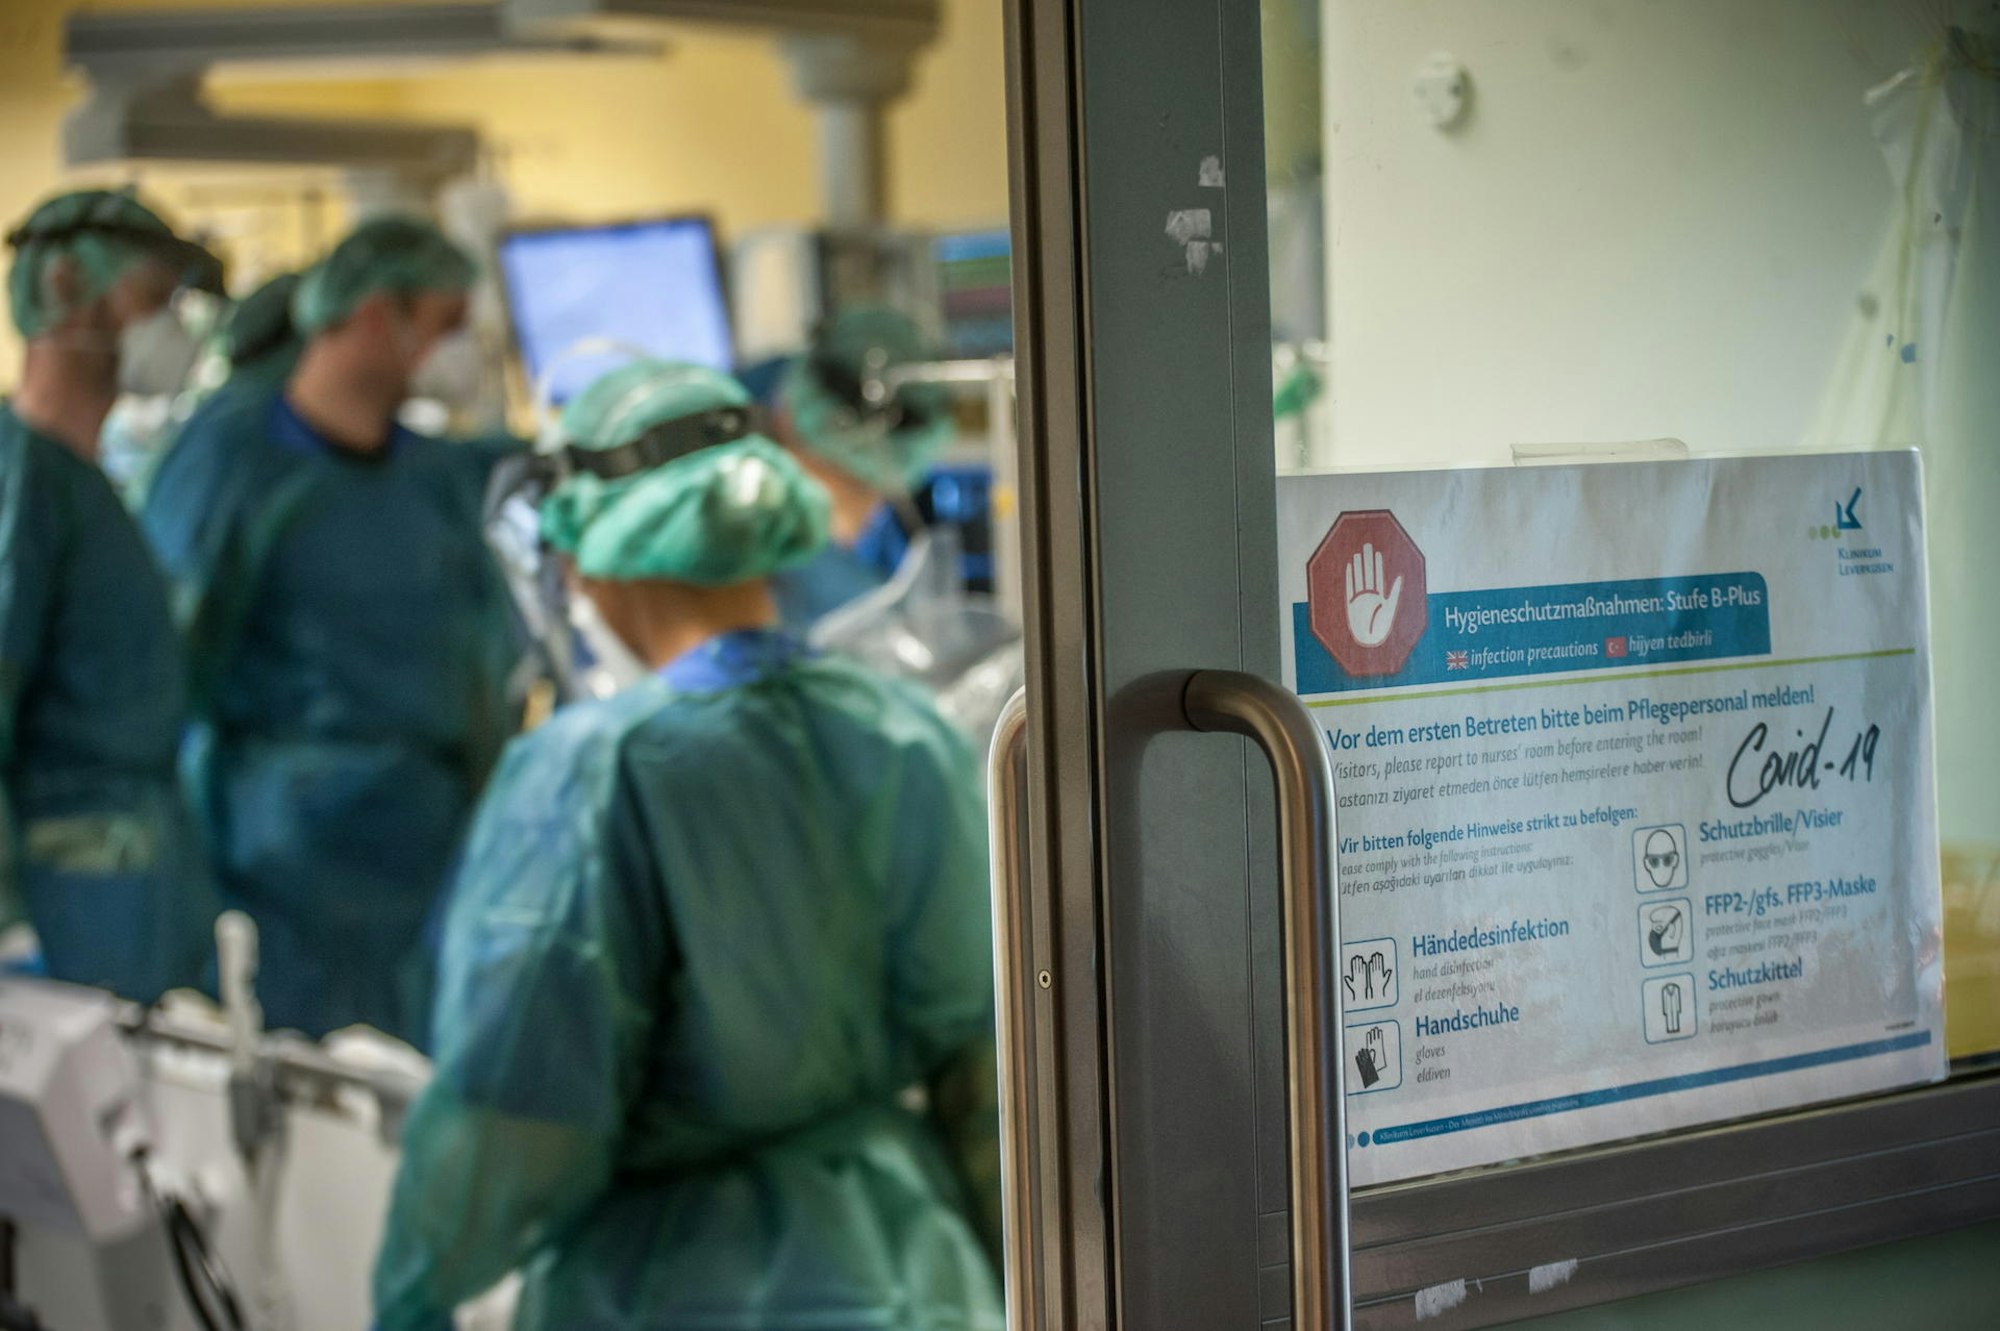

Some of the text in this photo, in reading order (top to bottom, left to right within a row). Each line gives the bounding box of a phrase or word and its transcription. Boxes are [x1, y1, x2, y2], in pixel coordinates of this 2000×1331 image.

[1445, 584, 1761, 634] Hygieneschutzmaßnahmen: Stufe B-Plus
[1471, 641, 1599, 670] infection precautions
[1629, 629, 1713, 656] hijyen tedbirli
[1326, 684, 1815, 751] Vor dem ersten Betreten bitte beim Pflegepersonal melden!
[1384, 756, 1422, 780] please
[1426, 752, 1463, 775] report
[1467, 750, 1478, 766] to
[1525, 743, 1555, 759] room
[1558, 736, 1593, 761] before
[1596, 732, 1644, 753] entering
[1647, 728, 1665, 747] the
[1668, 725, 1703, 744] room!
[1726, 705, 1880, 808] Covid-19
[1393, 785, 1435, 805] ziyaret
[1439, 777, 1490, 797] etmeden
[1493, 775, 1519, 791] önce
[1523, 770, 1558, 790] lütfen
[1562, 763, 1630, 784] hemşirelere
[1633, 759, 1665, 776] haber
[1669, 753, 1704, 772] verin!
[1363, 835, 1404, 852] bitten
[1407, 825, 1463, 850] folgende
[1467, 818, 1524, 839] Hinweise
[1526, 812, 1560, 832] strikt
[1563, 814, 1578, 827] zu
[1580, 805, 1639, 827] befolgen:
[1699, 807, 1843, 842] Schutzbrille/Visier
[1365, 856, 1399, 875] comply
[1401, 853, 1421, 868] with
[1423, 851, 1438, 867] the
[1438, 847, 1479, 868] following
[1469, 863, 1498, 879] dikkat
[1502, 860, 1514, 875] ile
[1705, 874, 1877, 917] FFP2-/gfs. FFP3-Maske
[1412, 918, 1569, 957] Händedesinfektion
[1413, 962, 1438, 980] hand
[1708, 957, 1803, 991] Schutzkittel
[1414, 987, 1423, 1003] el
[1416, 1002, 1520, 1038] Handschuhe
[1415, 1044, 1446, 1066] gloves
[1417, 1066, 1451, 1083] eldiven
